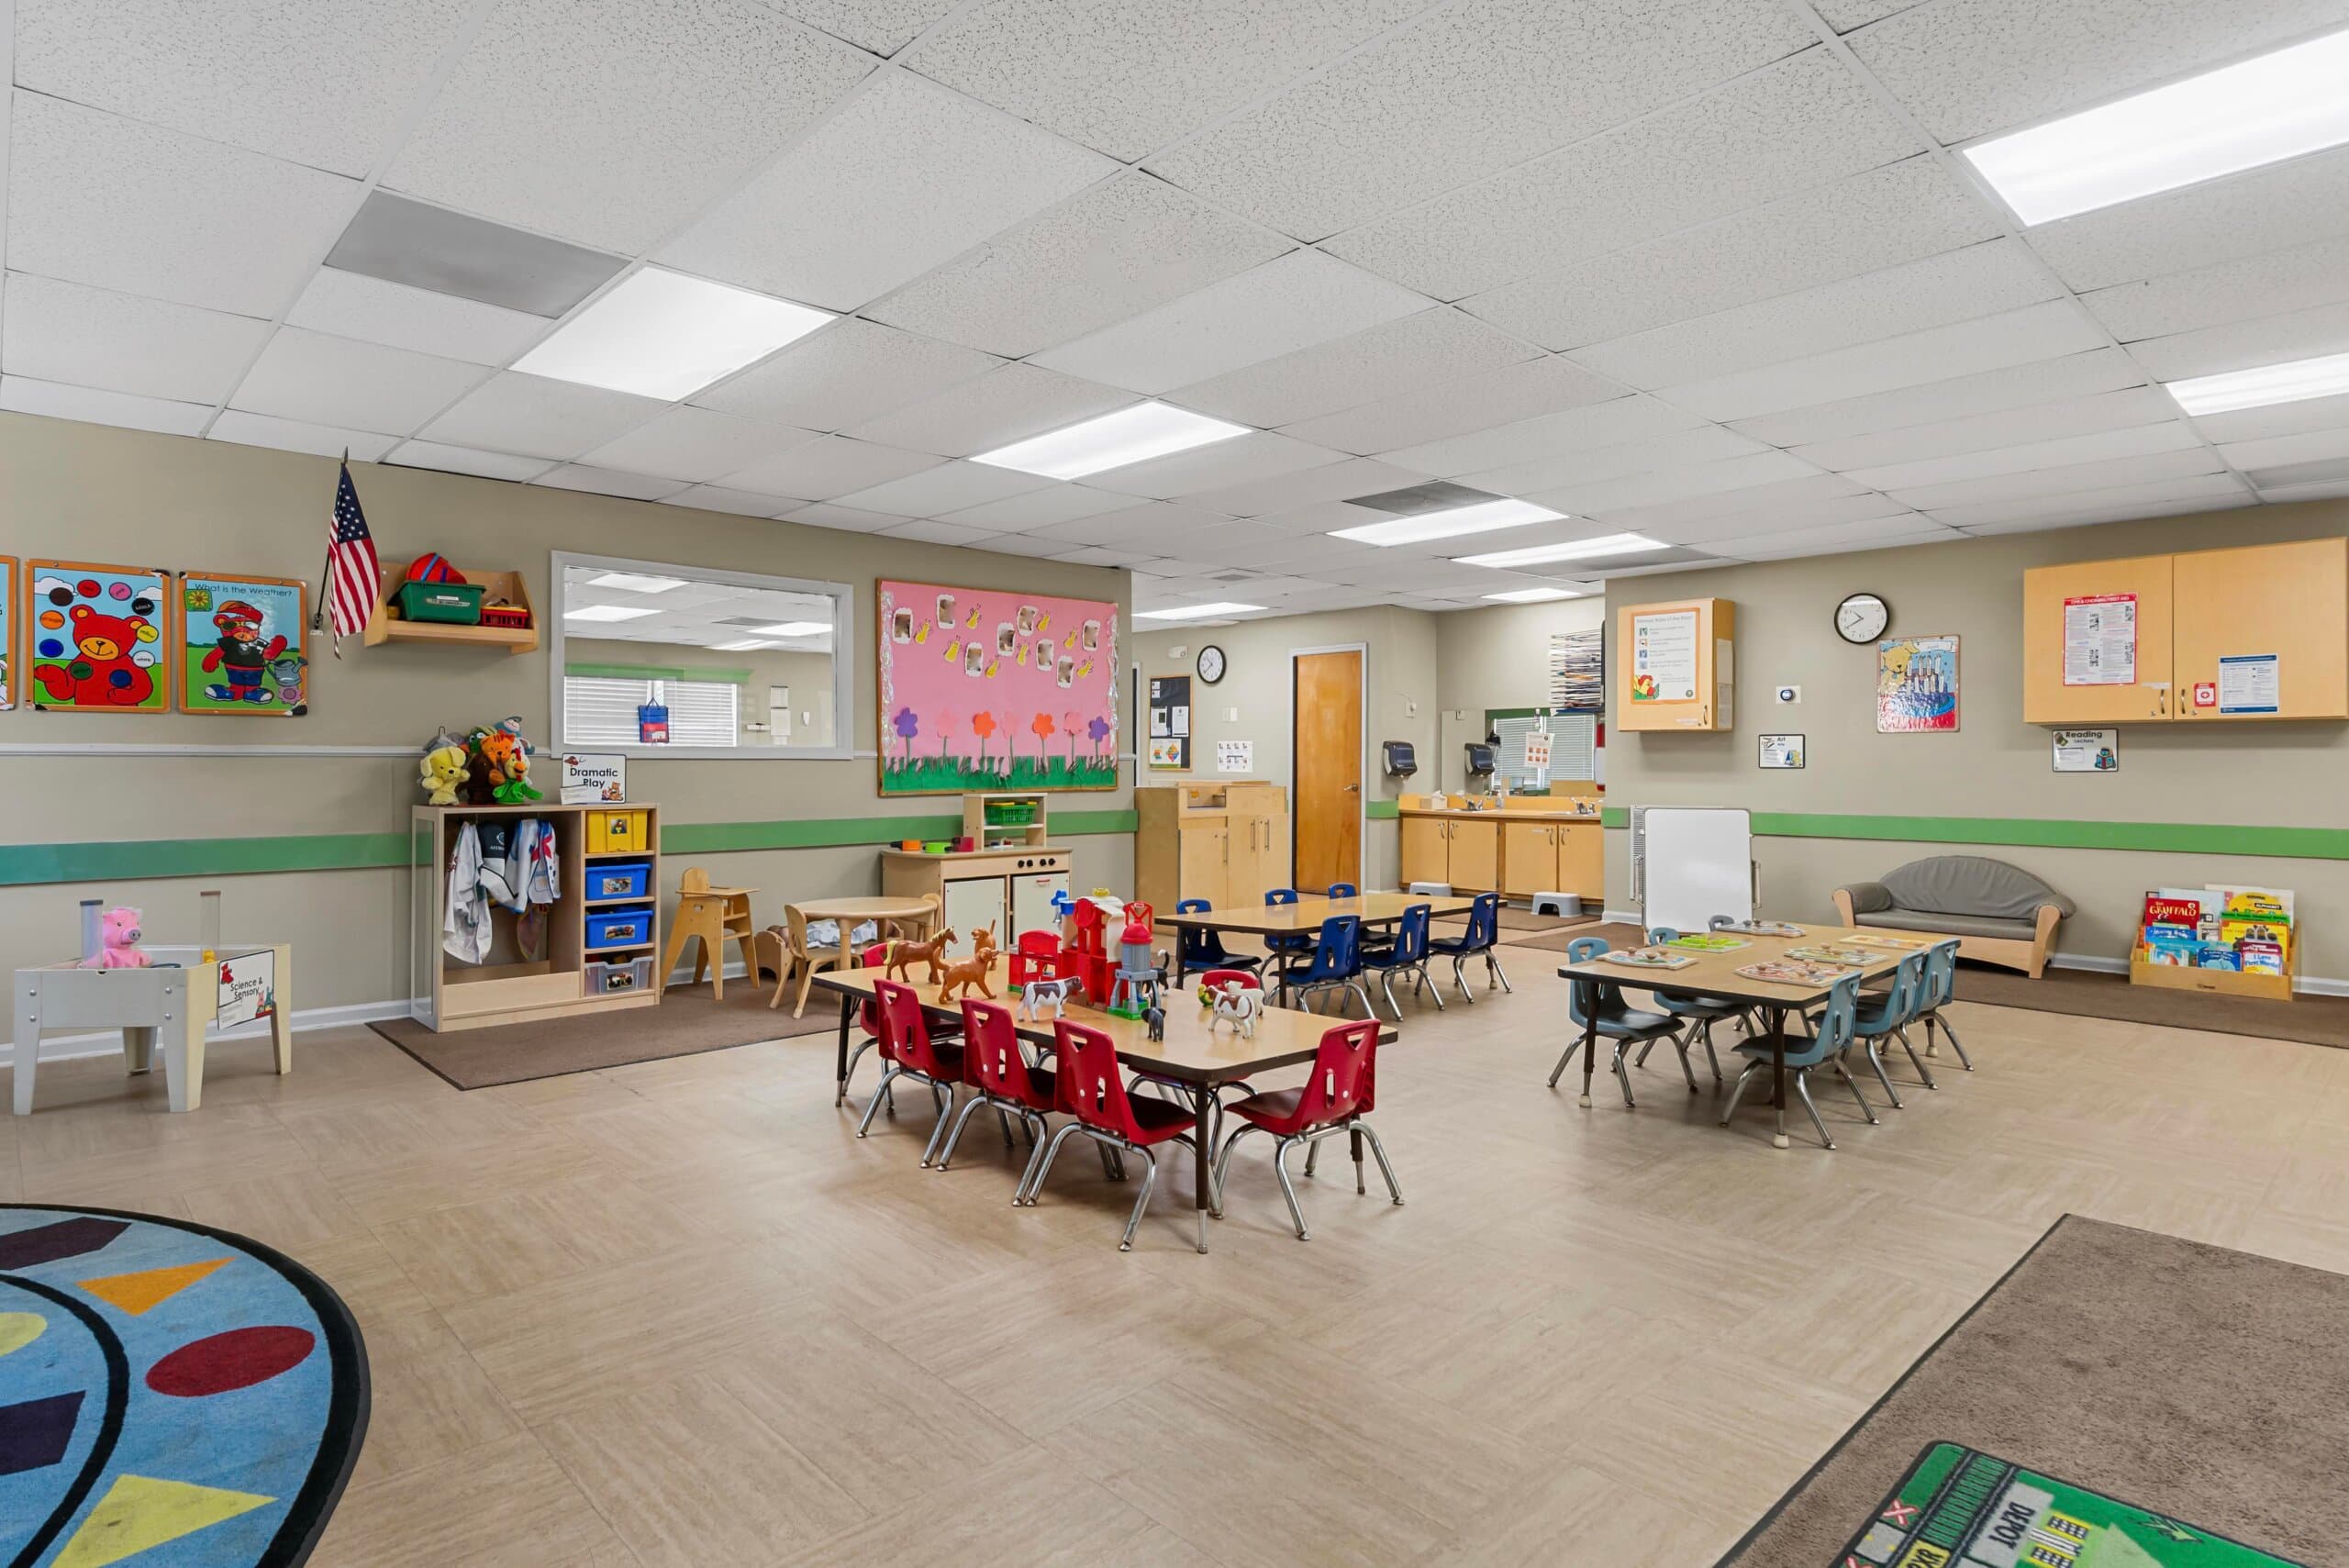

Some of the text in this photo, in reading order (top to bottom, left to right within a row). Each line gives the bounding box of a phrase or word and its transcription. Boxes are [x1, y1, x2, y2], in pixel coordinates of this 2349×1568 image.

[195, 584, 220, 592] What
[231, 586, 246, 595] the
[250, 587, 293, 597] Weather?
[2065, 730, 2103, 740] Reading
[570, 767, 618, 777] Dramatic
[583, 778, 606, 789] Play
[2149, 906, 2197, 917] GRUFFALO
[230, 976, 263, 992] Science &
[234, 986, 260, 1000] Sensory
[1988, 1501, 2036, 1550] DEPOT
